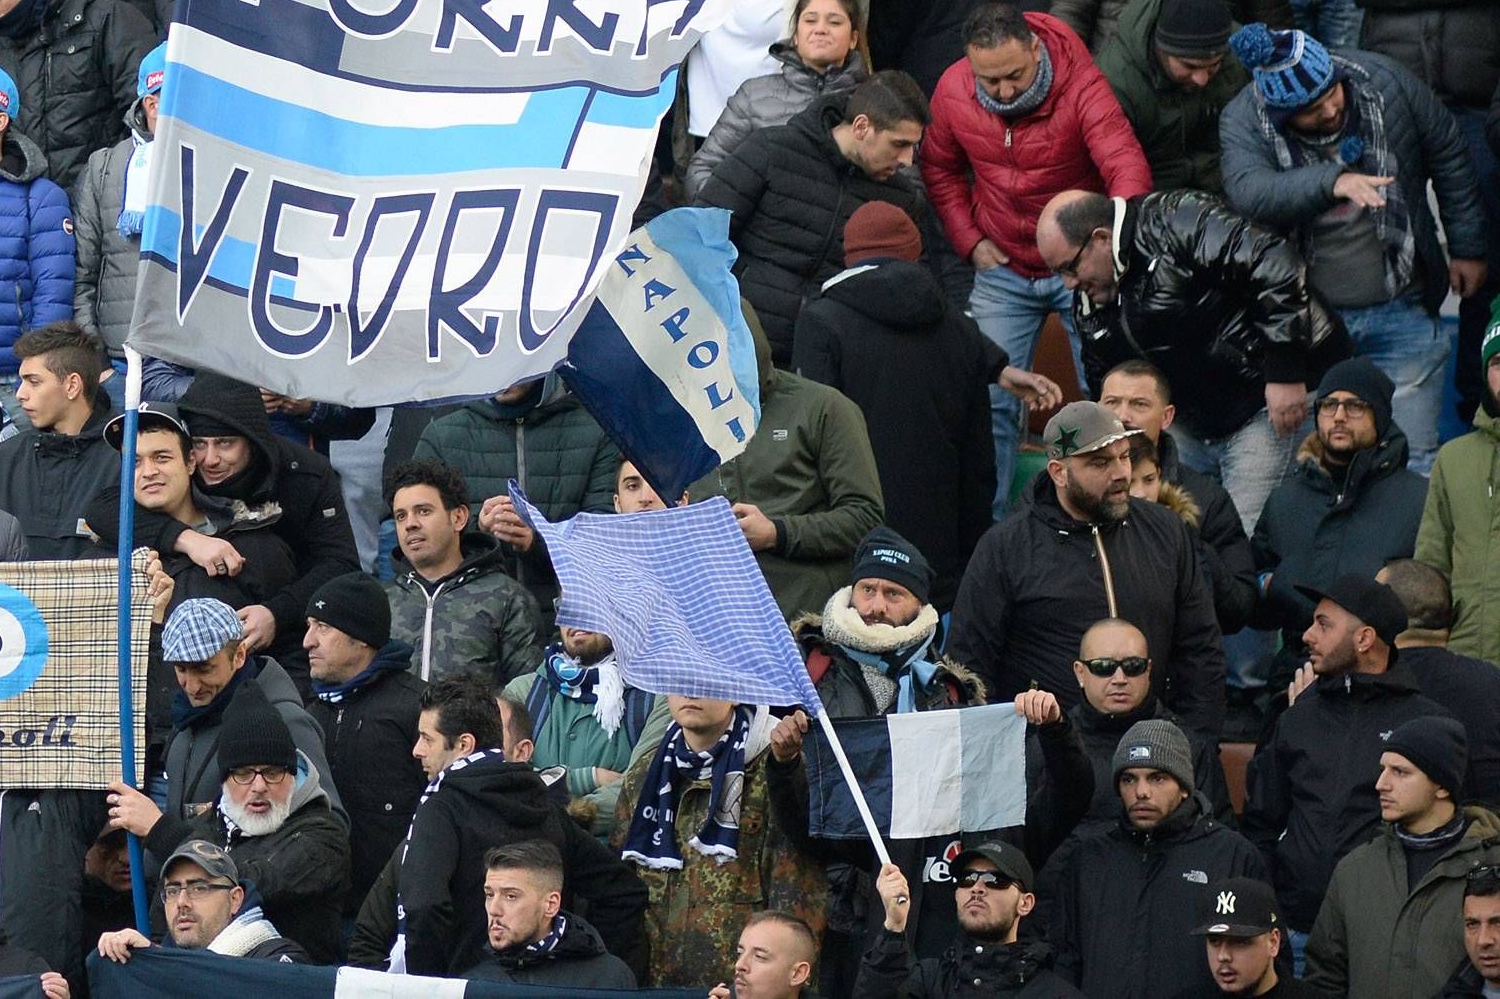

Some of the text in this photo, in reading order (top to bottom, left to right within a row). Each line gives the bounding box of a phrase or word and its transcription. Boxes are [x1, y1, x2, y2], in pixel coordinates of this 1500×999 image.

[176, 141, 623, 364] VEDRO
[615, 244, 746, 442] NAPOLI
[873, 549, 895, 557] NAPOLI
[1216, 891, 1236, 914] NY
